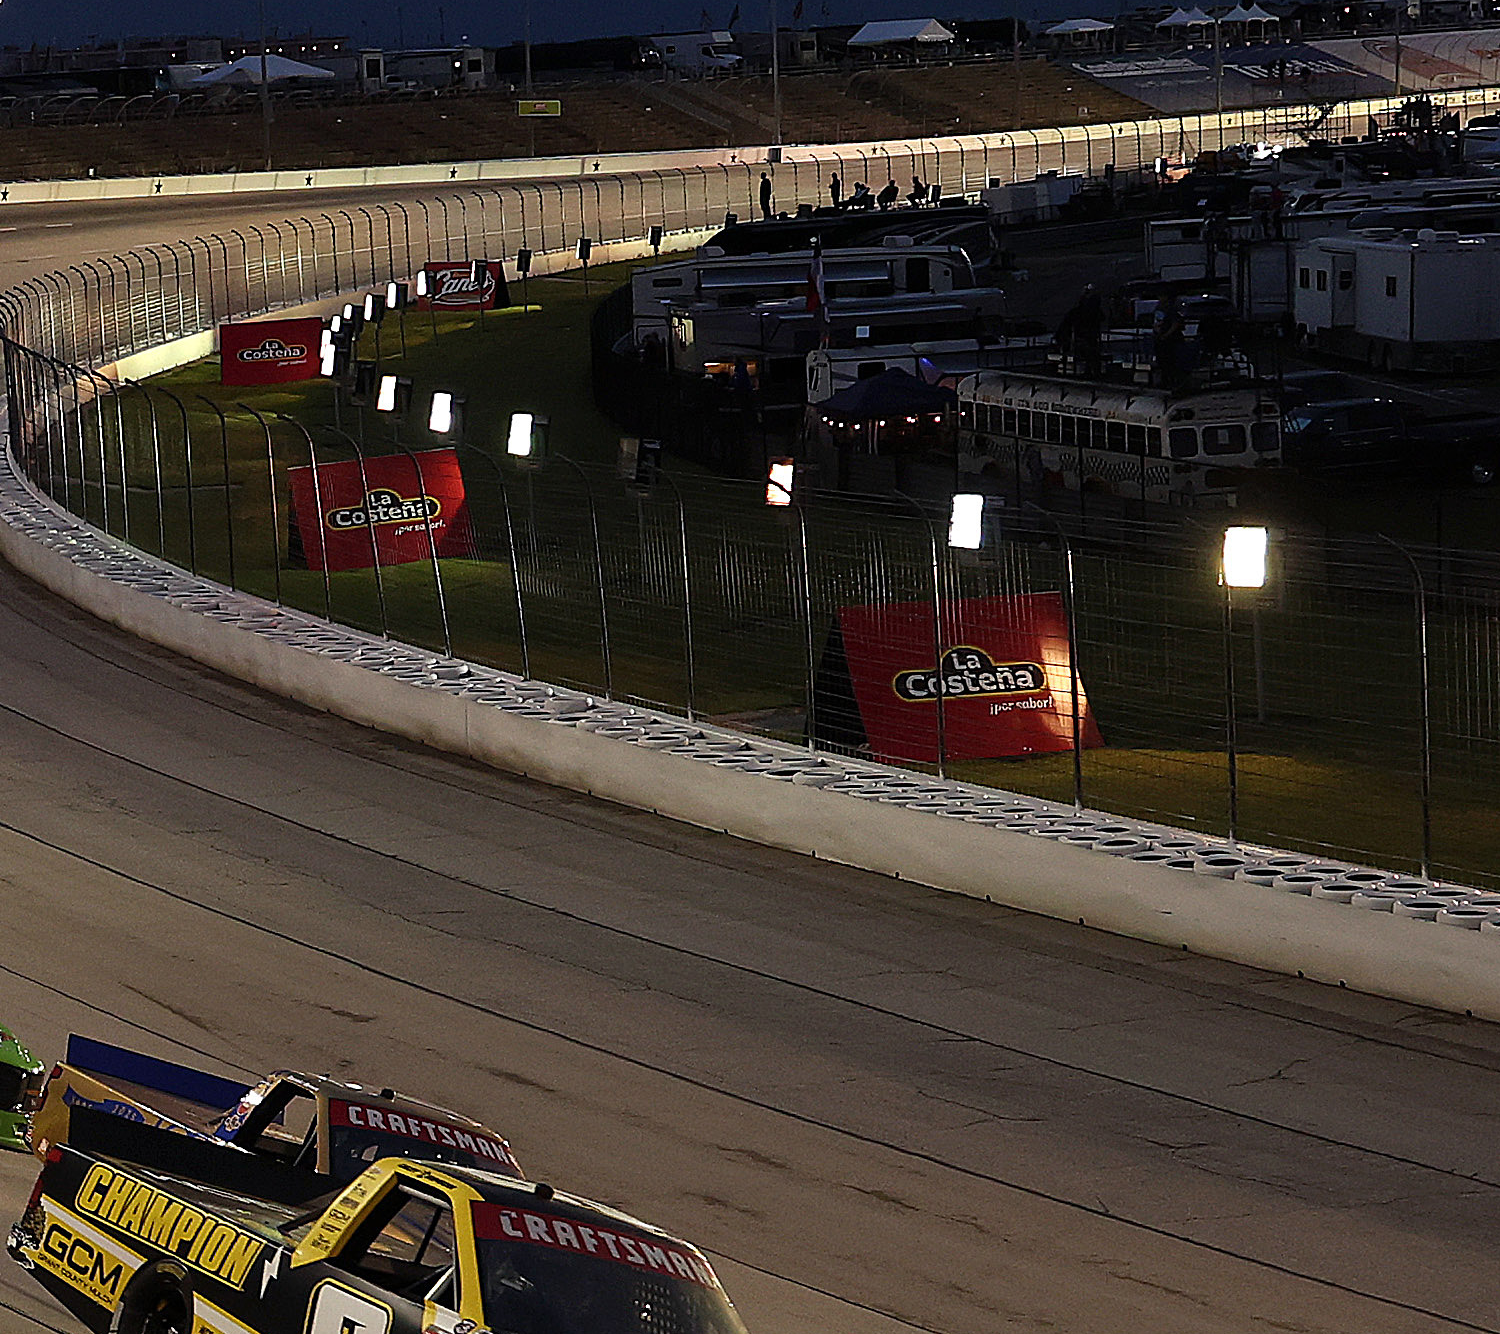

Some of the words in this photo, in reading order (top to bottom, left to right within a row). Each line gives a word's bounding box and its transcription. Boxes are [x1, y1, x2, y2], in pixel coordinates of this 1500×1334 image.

[370, 494, 392, 506] La
[414, 519, 447, 532] saor!
[905, 666, 1036, 697] Costeña
[951, 652, 982, 670] La
[347, 1105, 511, 1165] CRAFTSMAN
[77, 1163, 262, 1286] CHAMPION
[42, 1222, 125, 1297] GCM
[500, 1209, 718, 1289] CRAFTSMAN
